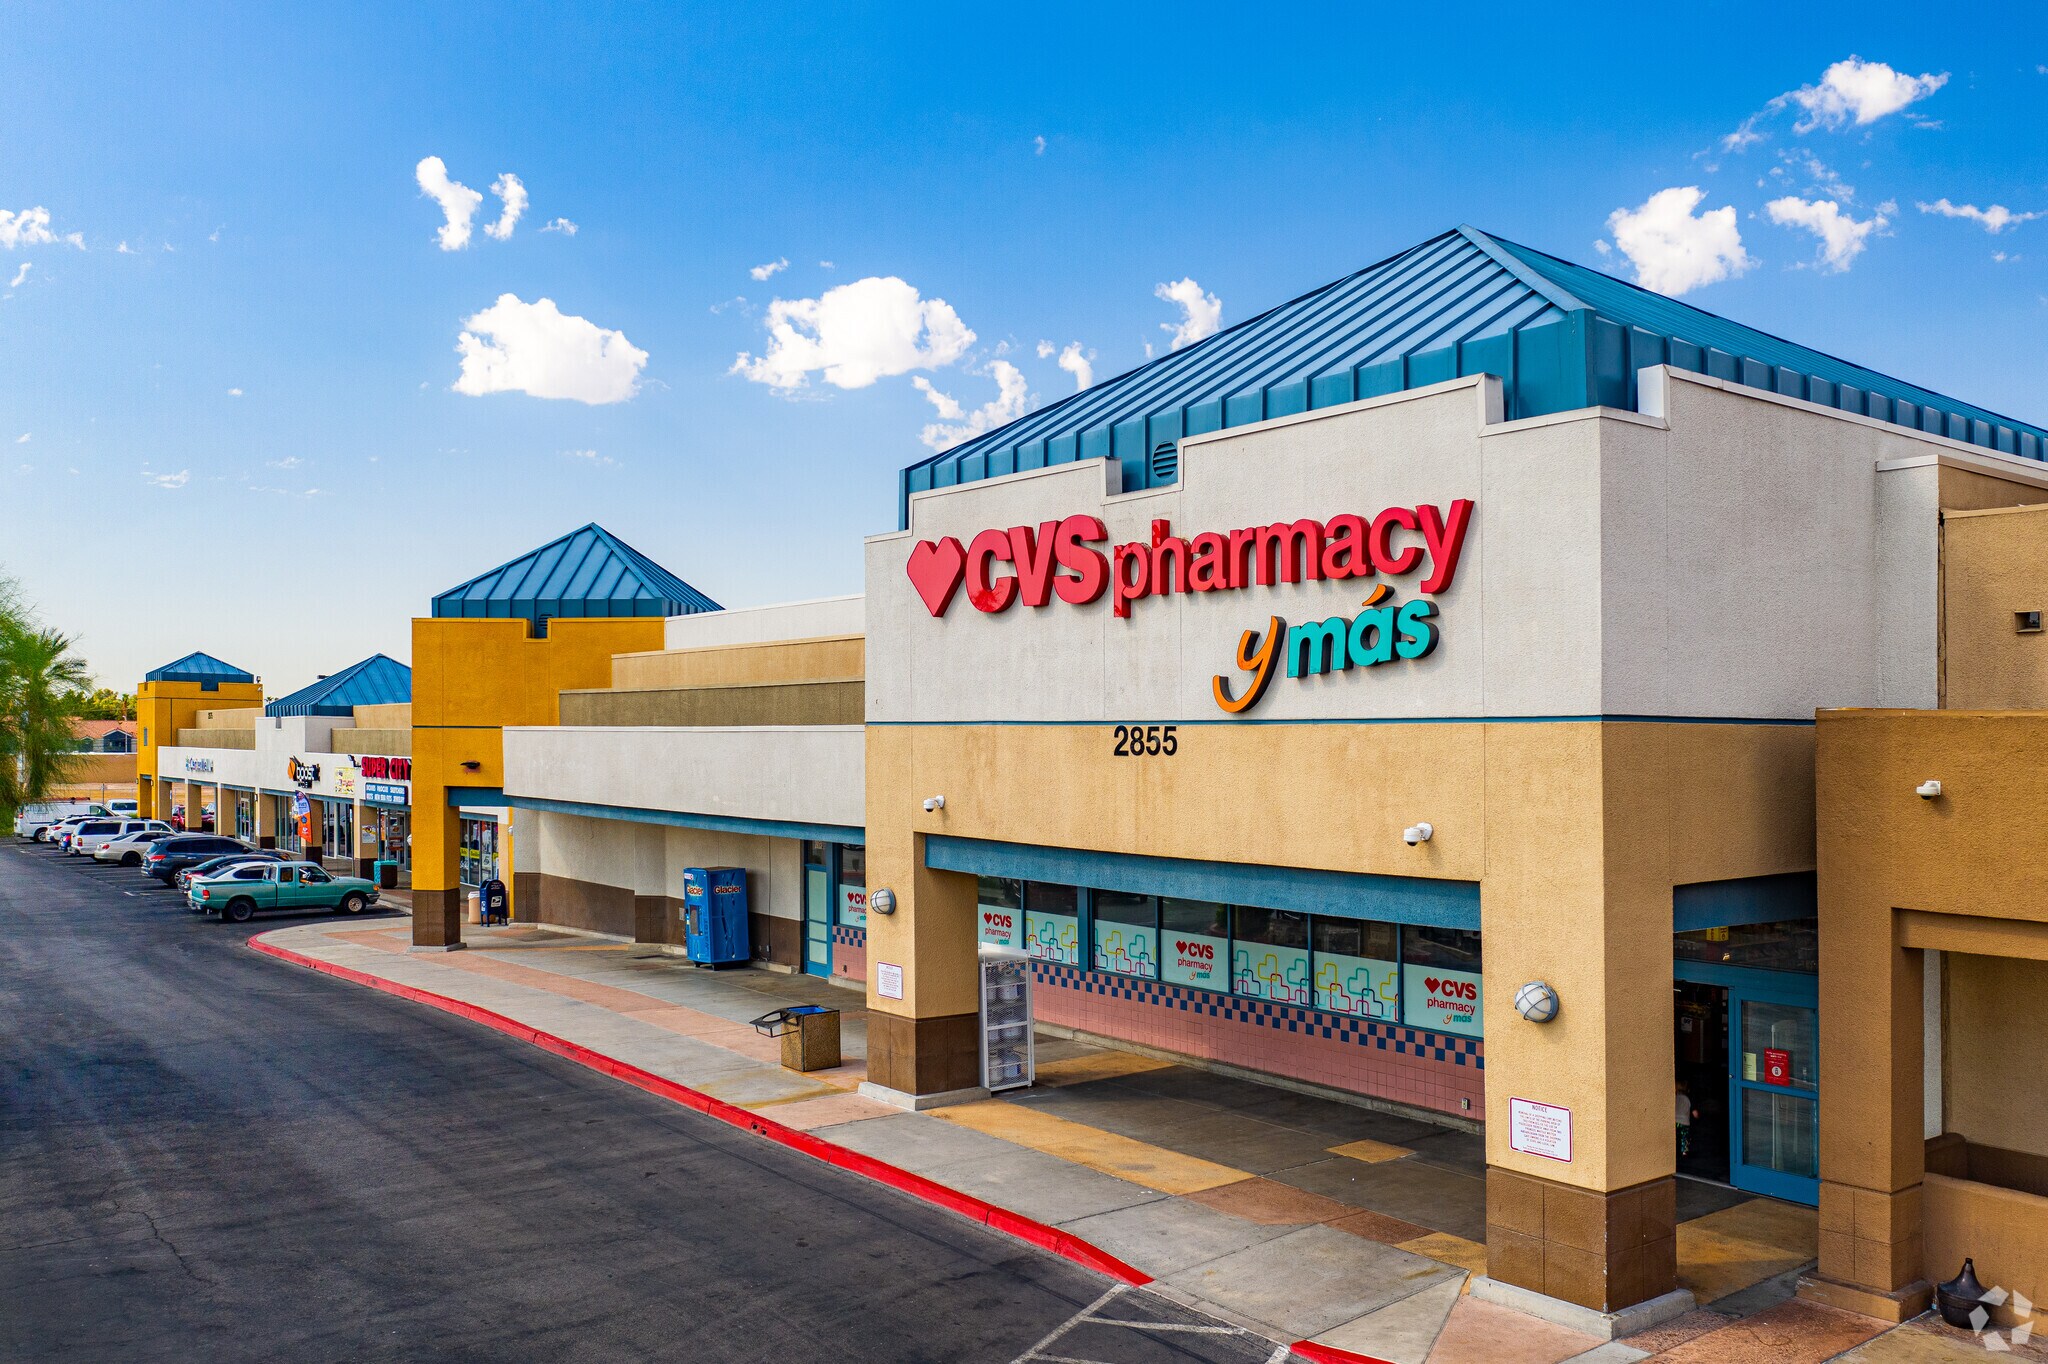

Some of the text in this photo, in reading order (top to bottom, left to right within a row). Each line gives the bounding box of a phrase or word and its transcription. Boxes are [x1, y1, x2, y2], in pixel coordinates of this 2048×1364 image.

[965, 498, 1474, 618] CVS pharmacy
[1212, 583, 1439, 713] y más
[1113, 725, 1177, 757] 2855
[361, 756, 411, 780] SUPER CITY
[714, 885, 741, 894] Glacier
[854, 893, 866, 905] CV
[993, 913, 1012, 928] CVS
[985, 927, 1011, 939] pharmacy
[1188, 942, 1214, 960] CVS
[1177, 957, 1213, 973] pharmacy
[1441, 979, 1477, 1000] CVS
[1427, 996, 1476, 1015] pharmacy
[1443, 1013, 1472, 1025] y más
